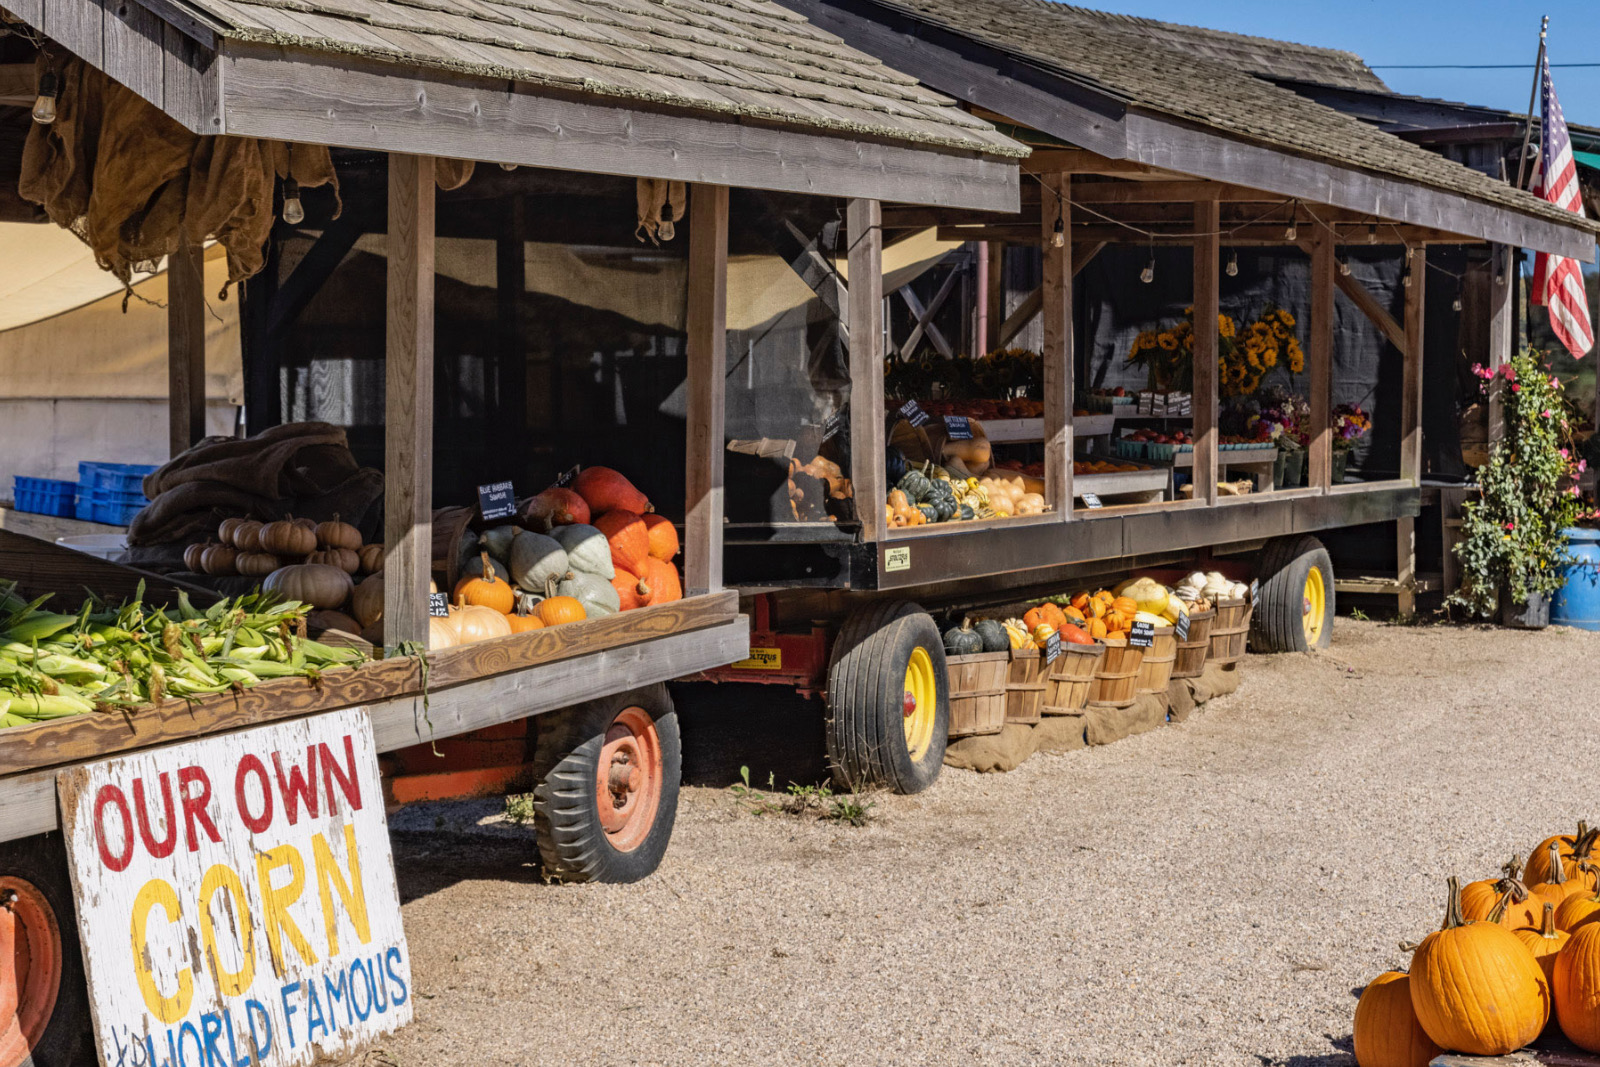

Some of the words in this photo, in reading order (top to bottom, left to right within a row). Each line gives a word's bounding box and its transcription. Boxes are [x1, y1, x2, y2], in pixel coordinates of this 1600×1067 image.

[94, 765, 223, 872] OUR
[234, 734, 363, 834] OWN
[130, 823, 372, 1025] CORN
[146, 999, 274, 1067] WORLD
[280, 946, 408, 1049] FAMOUS
